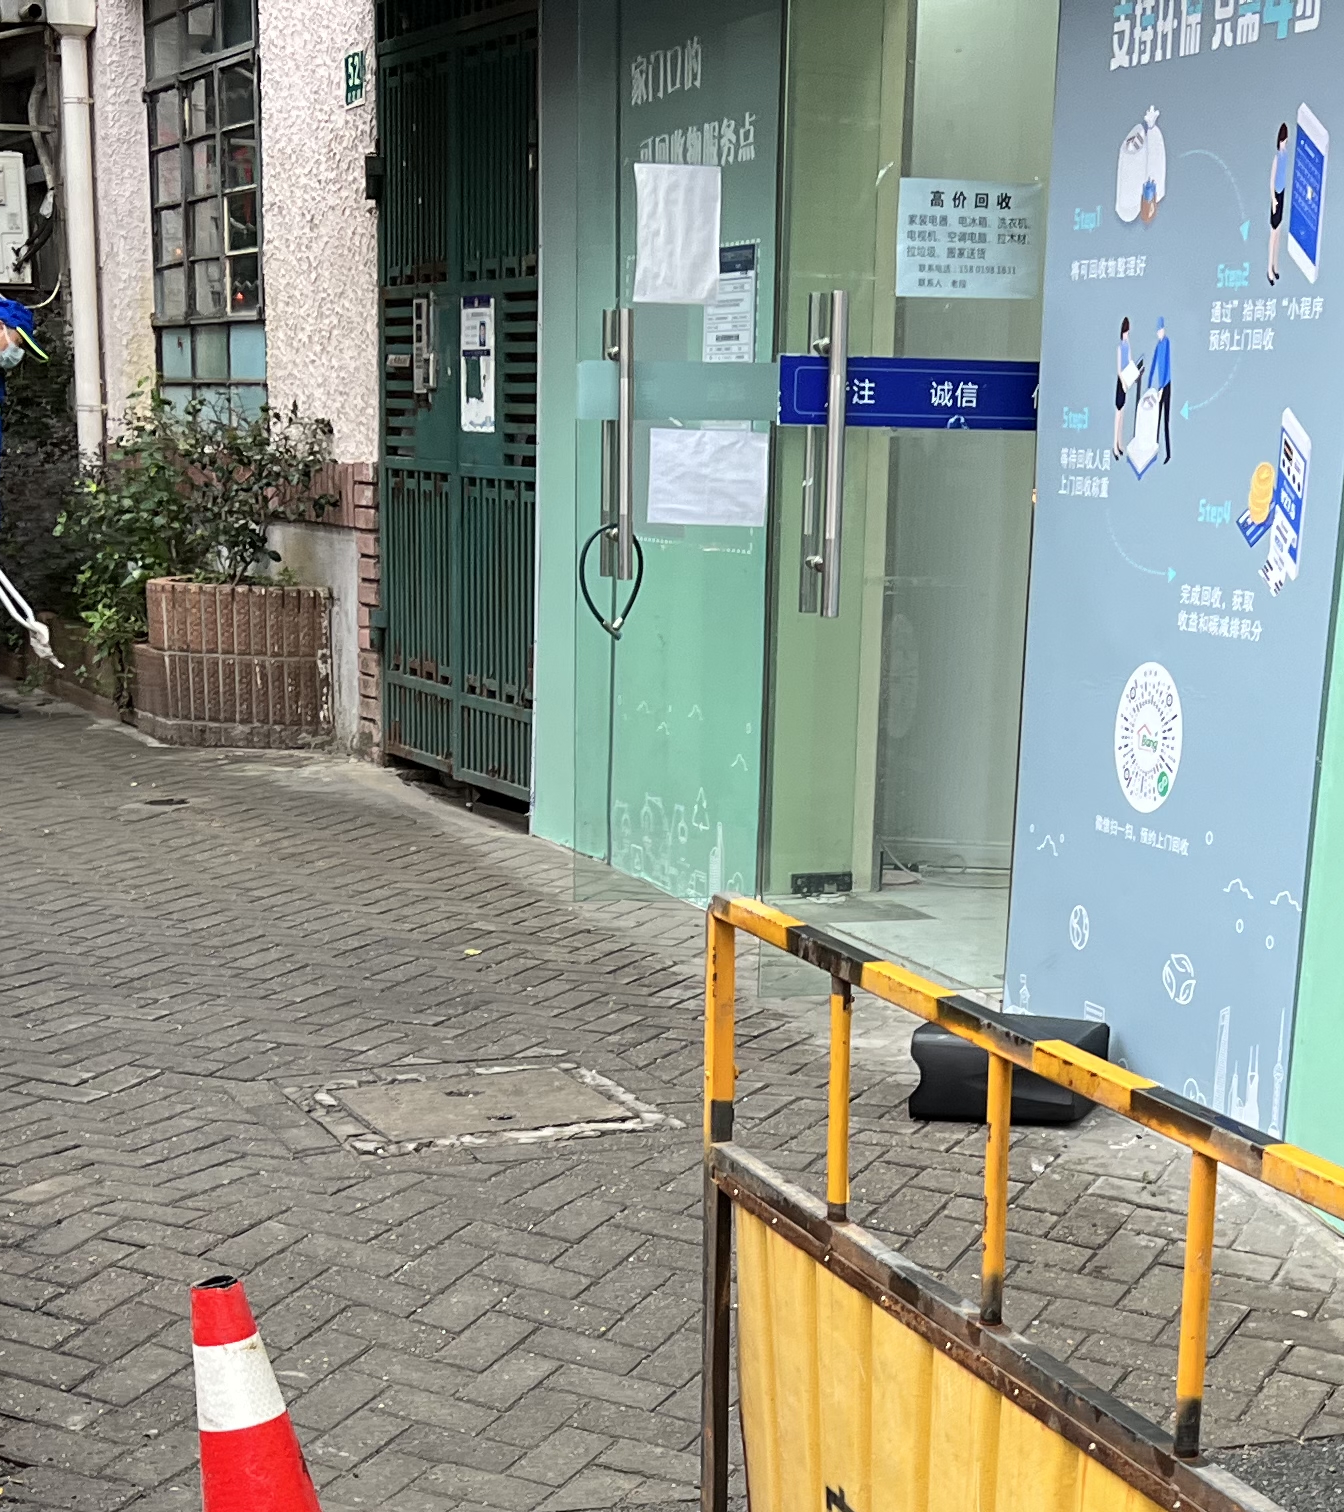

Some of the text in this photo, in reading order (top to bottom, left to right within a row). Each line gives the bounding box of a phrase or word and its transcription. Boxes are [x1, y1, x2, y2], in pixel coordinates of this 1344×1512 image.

[631, 36, 701, 105] 家门口的
[930, 190, 1012, 210] 高价回收
[1071, 255, 1146, 281] 将可回收物整理好
[1209, 328, 1275, 351] 预约上门回收
[930, 381, 978, 409] 诚信
[1060, 447, 1111, 471] 等待回收人员
